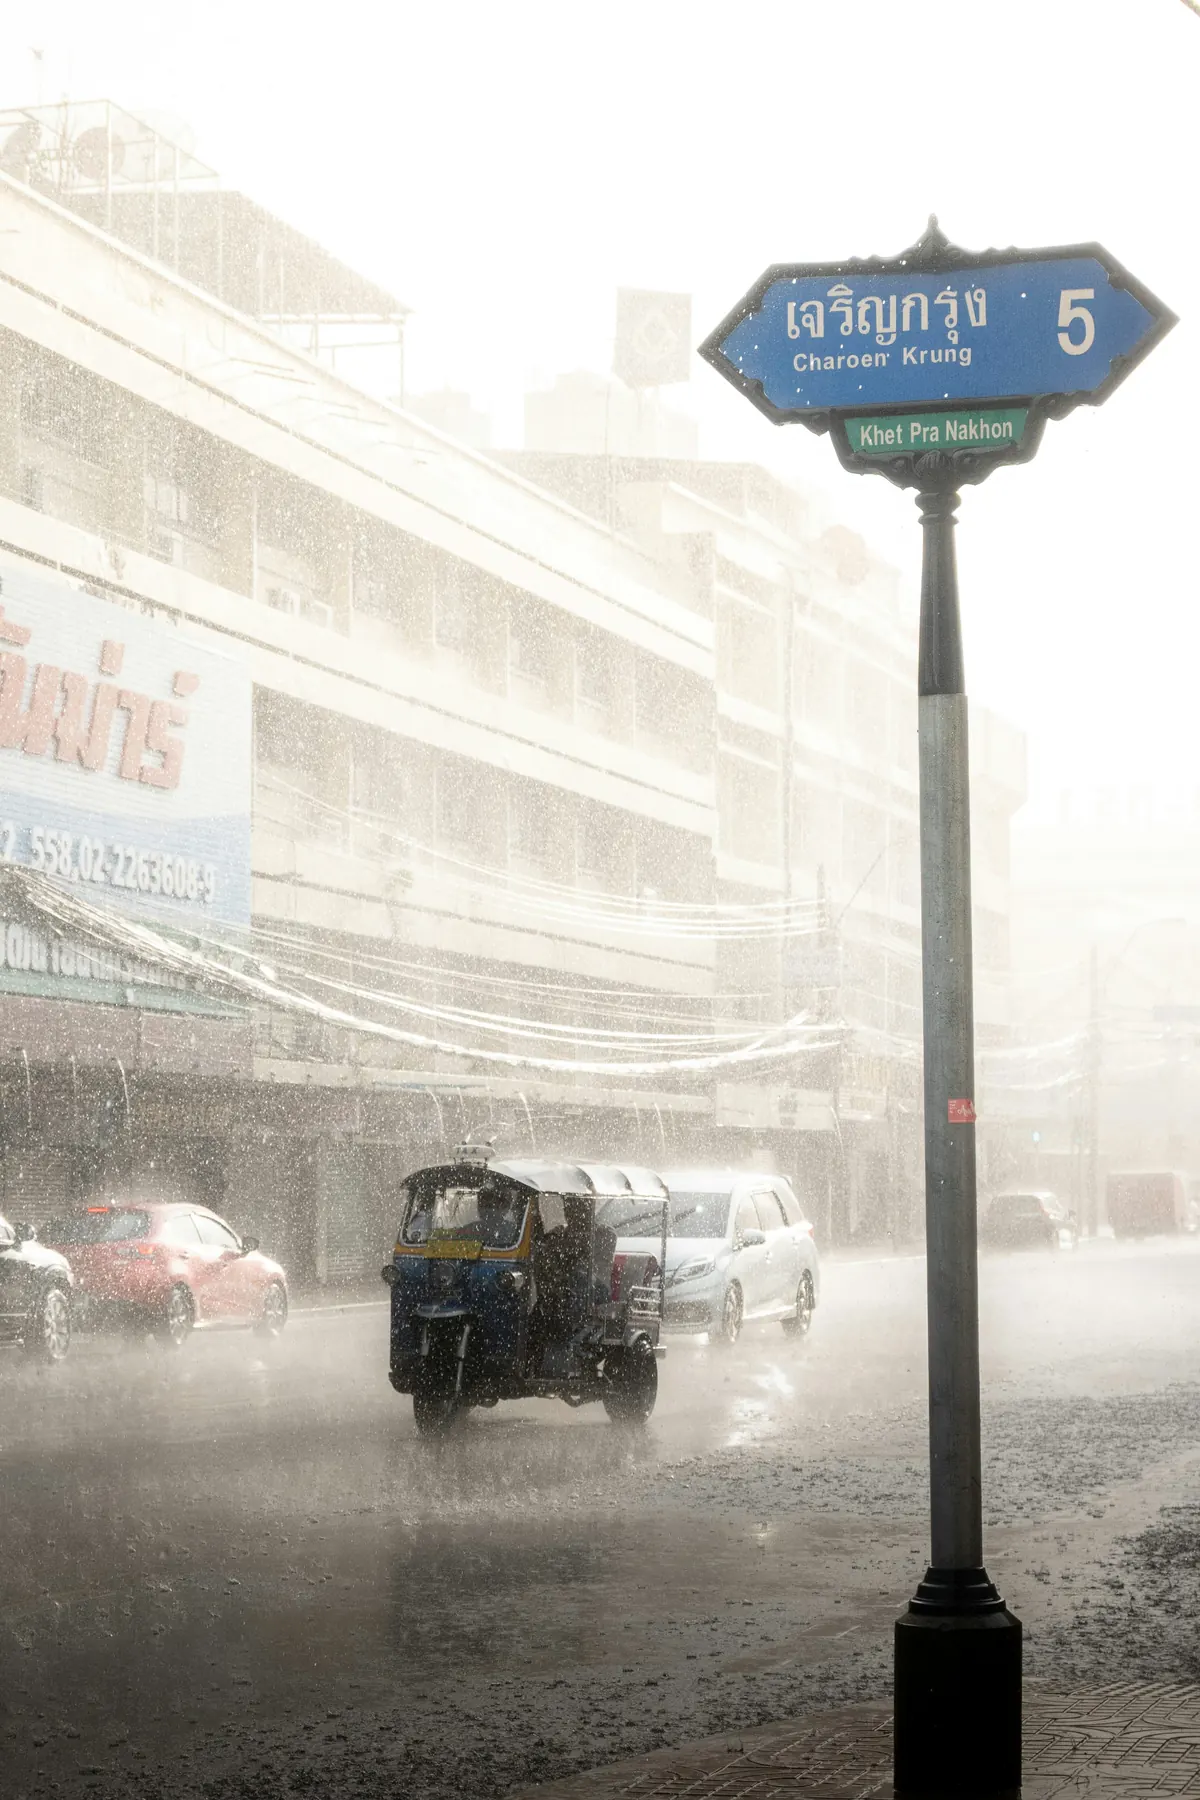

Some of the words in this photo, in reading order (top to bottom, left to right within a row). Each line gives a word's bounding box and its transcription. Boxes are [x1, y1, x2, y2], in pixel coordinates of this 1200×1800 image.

[787, 284, 987, 346] เจริญกรุง
[1057, 288, 1095, 356] 5
[793, 352, 887, 372] Charoen
[903, 346, 972, 367] Krung
[860, 423, 903, 446] Khet
[910, 422, 939, 443] Pra
[945, 418, 1013, 441] Nakhon
